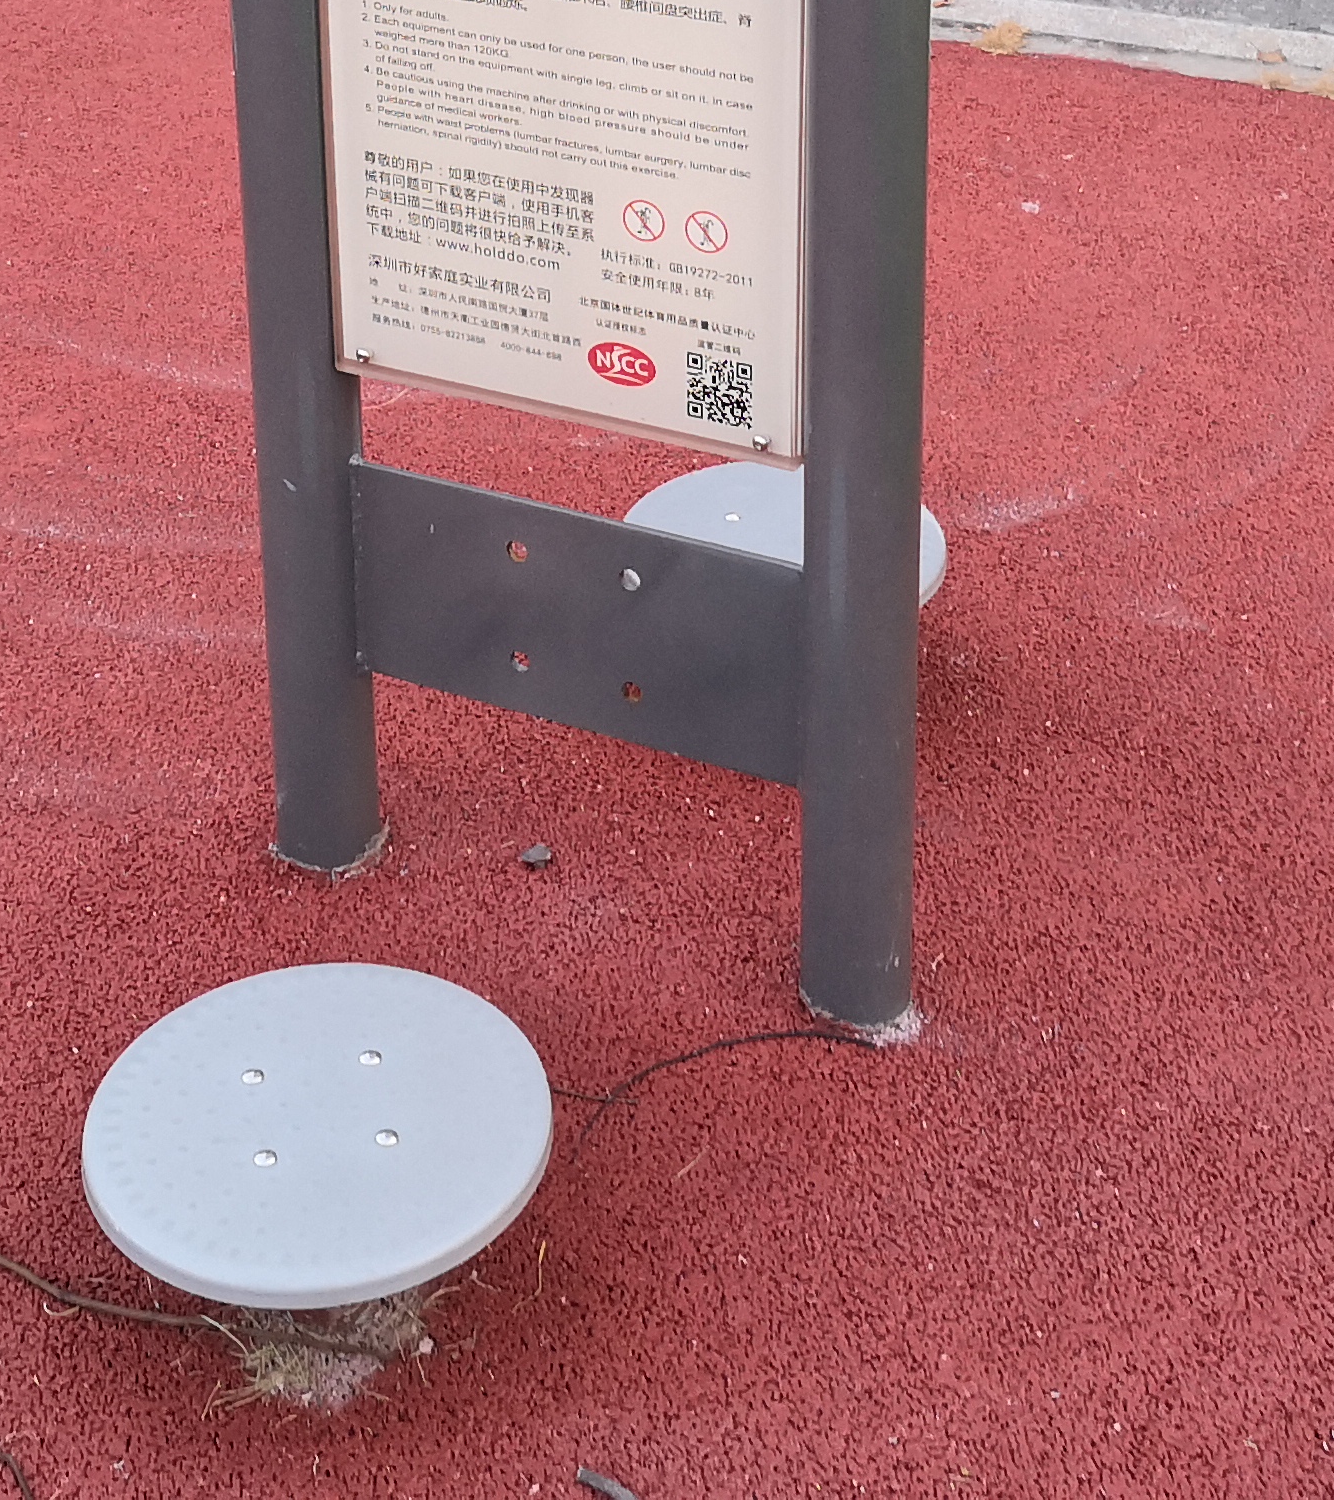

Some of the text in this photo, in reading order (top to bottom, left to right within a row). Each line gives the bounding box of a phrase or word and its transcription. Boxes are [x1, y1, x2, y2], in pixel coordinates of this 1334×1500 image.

[368, 253, 552, 304] 深圳市好家庭实业有限公司
[595, 346, 649, 377] NSCC
